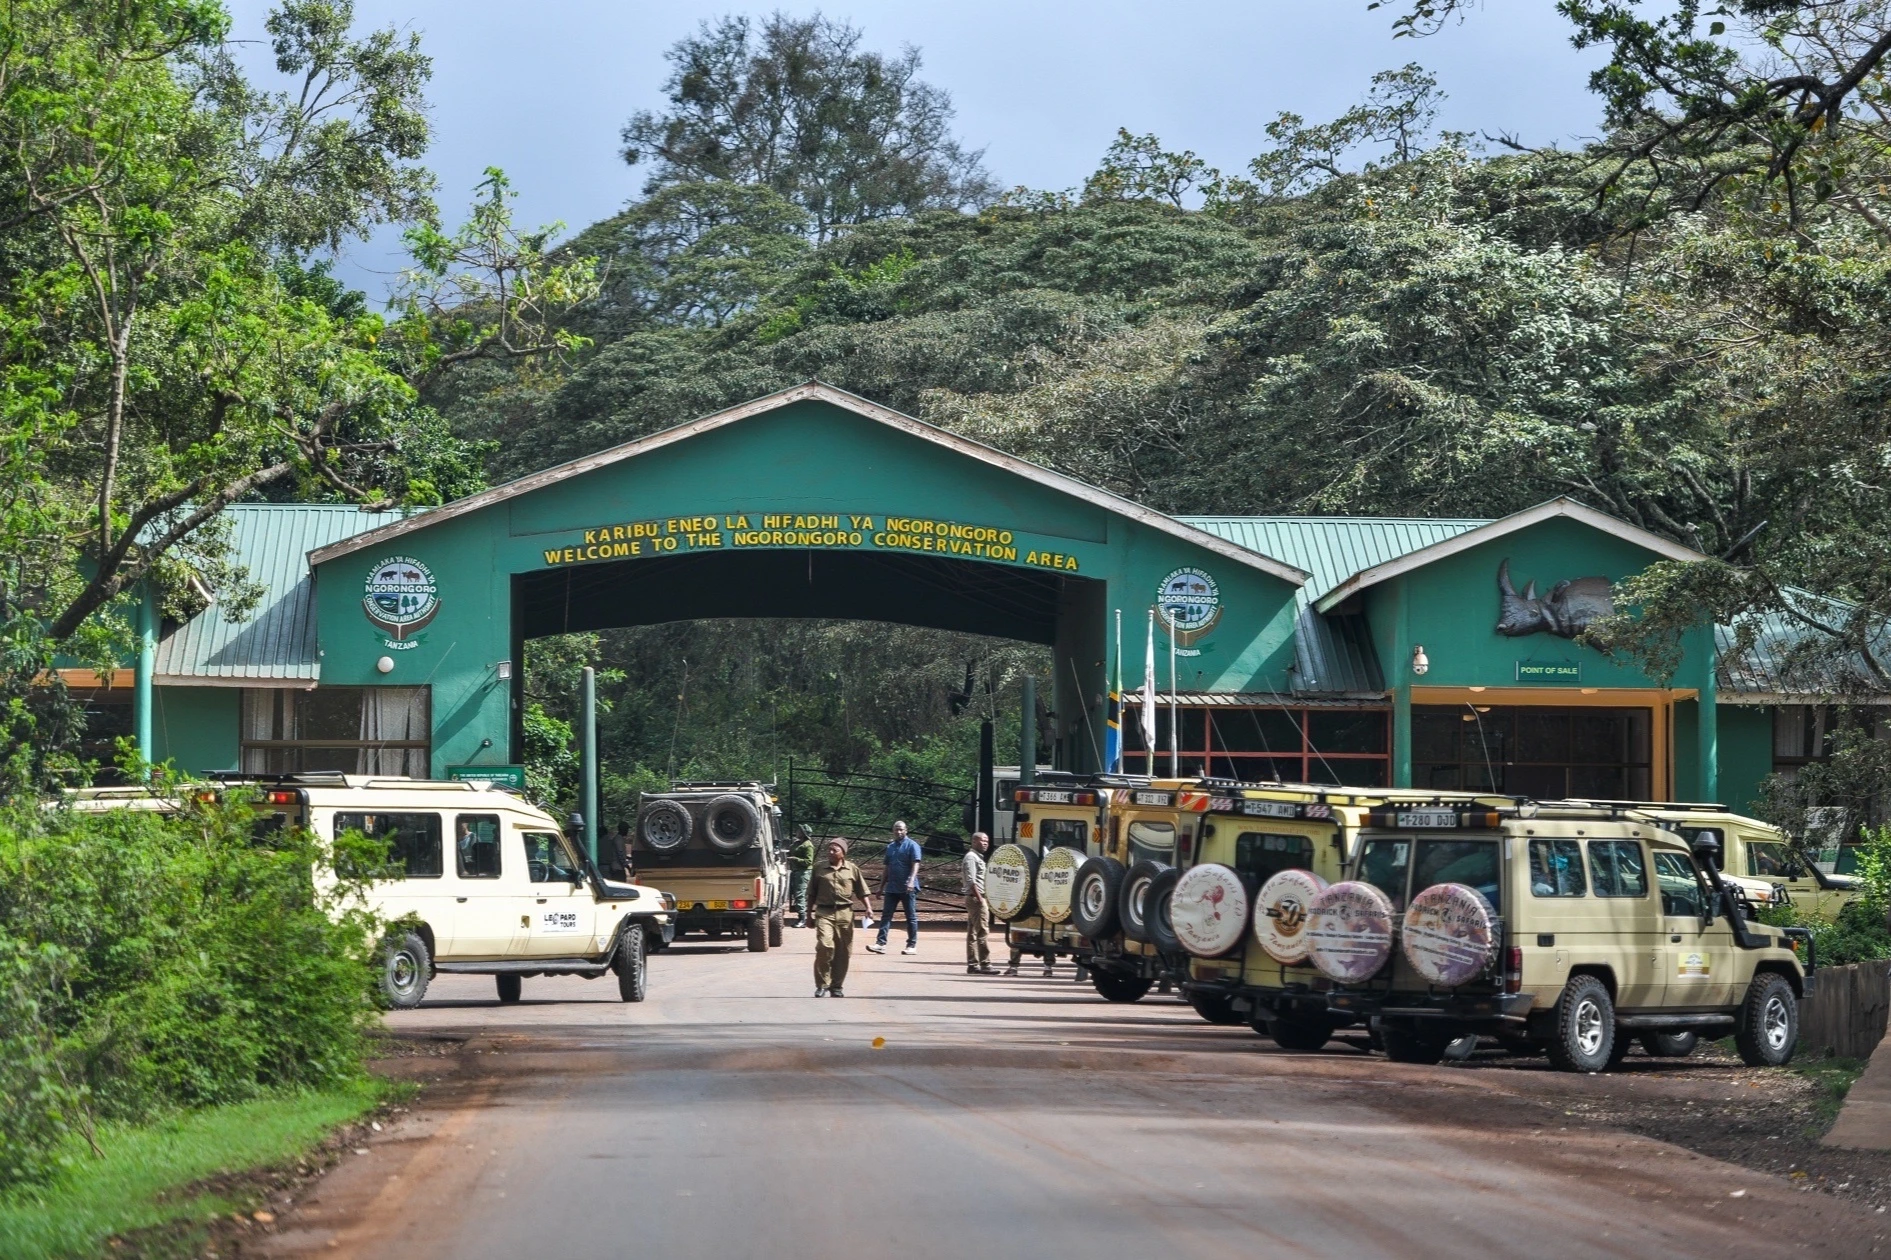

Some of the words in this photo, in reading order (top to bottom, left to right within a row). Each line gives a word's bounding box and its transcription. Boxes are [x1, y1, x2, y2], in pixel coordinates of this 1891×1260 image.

[585, 523, 658, 544] KARIBU
[667, 516, 717, 533] ENEO
[725, 515, 748, 529] LA
[763, 515, 838, 529] HIFADHI
[851, 516, 874, 530] YA
[886, 518, 1012, 545] NGORONGORO
[545, 541, 641, 564] WELCOME
[652, 537, 677, 551] TO
[689, 533, 721, 546] THE
[734, 531, 862, 546] NGORONGORO
[874, 532, 1016, 561] CONSERVATION
[1026, 551, 1078, 570] AREA
[365, 557, 395, 584] MAMLAKA
[405, 557, 431, 575] HIFADHI
[427, 574, 436, 584] YA
[1192, 568, 1217, 588] HIFADHI
[365, 584, 437, 593] NGORONGORO
[1158, 595, 1219, 604] NGORONGORO
[384, 639, 419, 650] TANZANIA
[1520, 666, 1544, 674] POINT
[1320, 892, 1374, 909] TANZANIA
[1423, 893, 1478, 917] TANZANIA
[1456, 915, 1487, 929] SAFARIS
